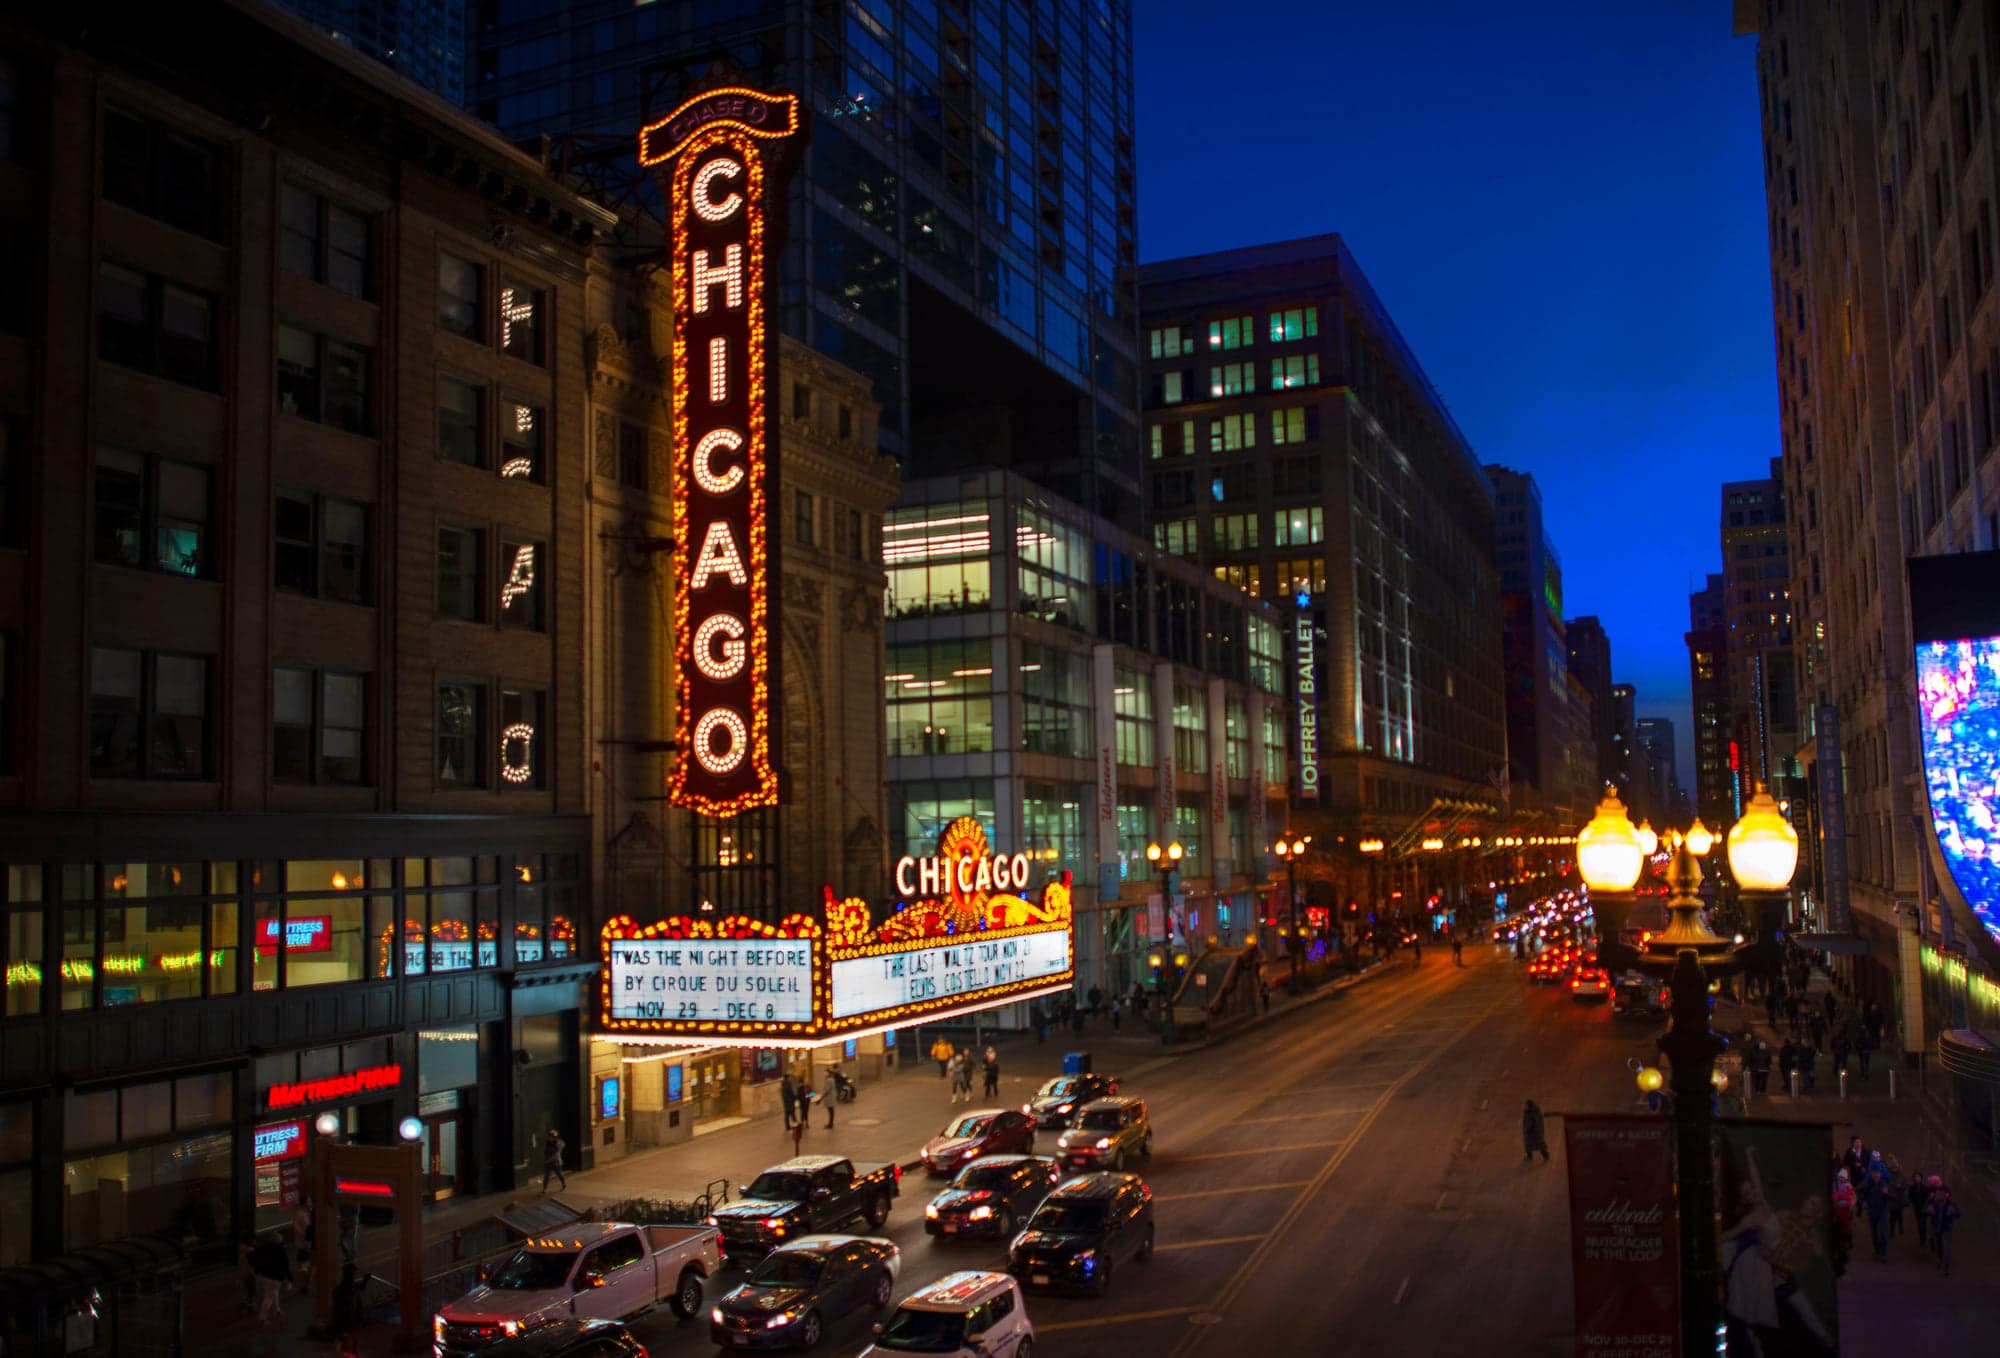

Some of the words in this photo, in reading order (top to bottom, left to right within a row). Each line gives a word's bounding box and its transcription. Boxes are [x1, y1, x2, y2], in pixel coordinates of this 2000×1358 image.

[689, 157, 750, 776] CHICAGO
[1297, 617, 1315, 694] BALLET
[1299, 701, 1318, 794] JOFFREY
[896, 852, 1030, 896] CHICAGO
[267, 918, 324, 936] MTTRESS
[286, 932, 313, 946] IRM
[656, 950, 682, 966] THE
[689, 950, 739, 967] NIGHT
[746, 950, 808, 967] BEFORE
[883, 957, 905, 980] THE
[908, 952, 936, 975] LAST
[979, 943, 998, 962] TOUR
[625, 975, 644, 992] BY
[653, 976, 708, 992] CIRQUE
[716, 976, 738, 992] DU
[745, 976, 801, 993] SOLEIL
[910, 975, 937, 999] ELVIS
[944, 967, 989, 993] COSTELLO
[1015, 959, 1025, 978] 22
[636, 1001, 665, 1018] NOV
[679, 1002, 698, 1018] 29
[727, 1002, 757, 1019] DEC
[765, 1003, 774, 1019] 8
[1585, 1199, 1664, 1223] celebrate
[1612, 1224, 1634, 1235] THE
[1585, 1236, 1663, 1249] NUTCRACKER
[1629, 1248, 1664, 1263] LOOP
